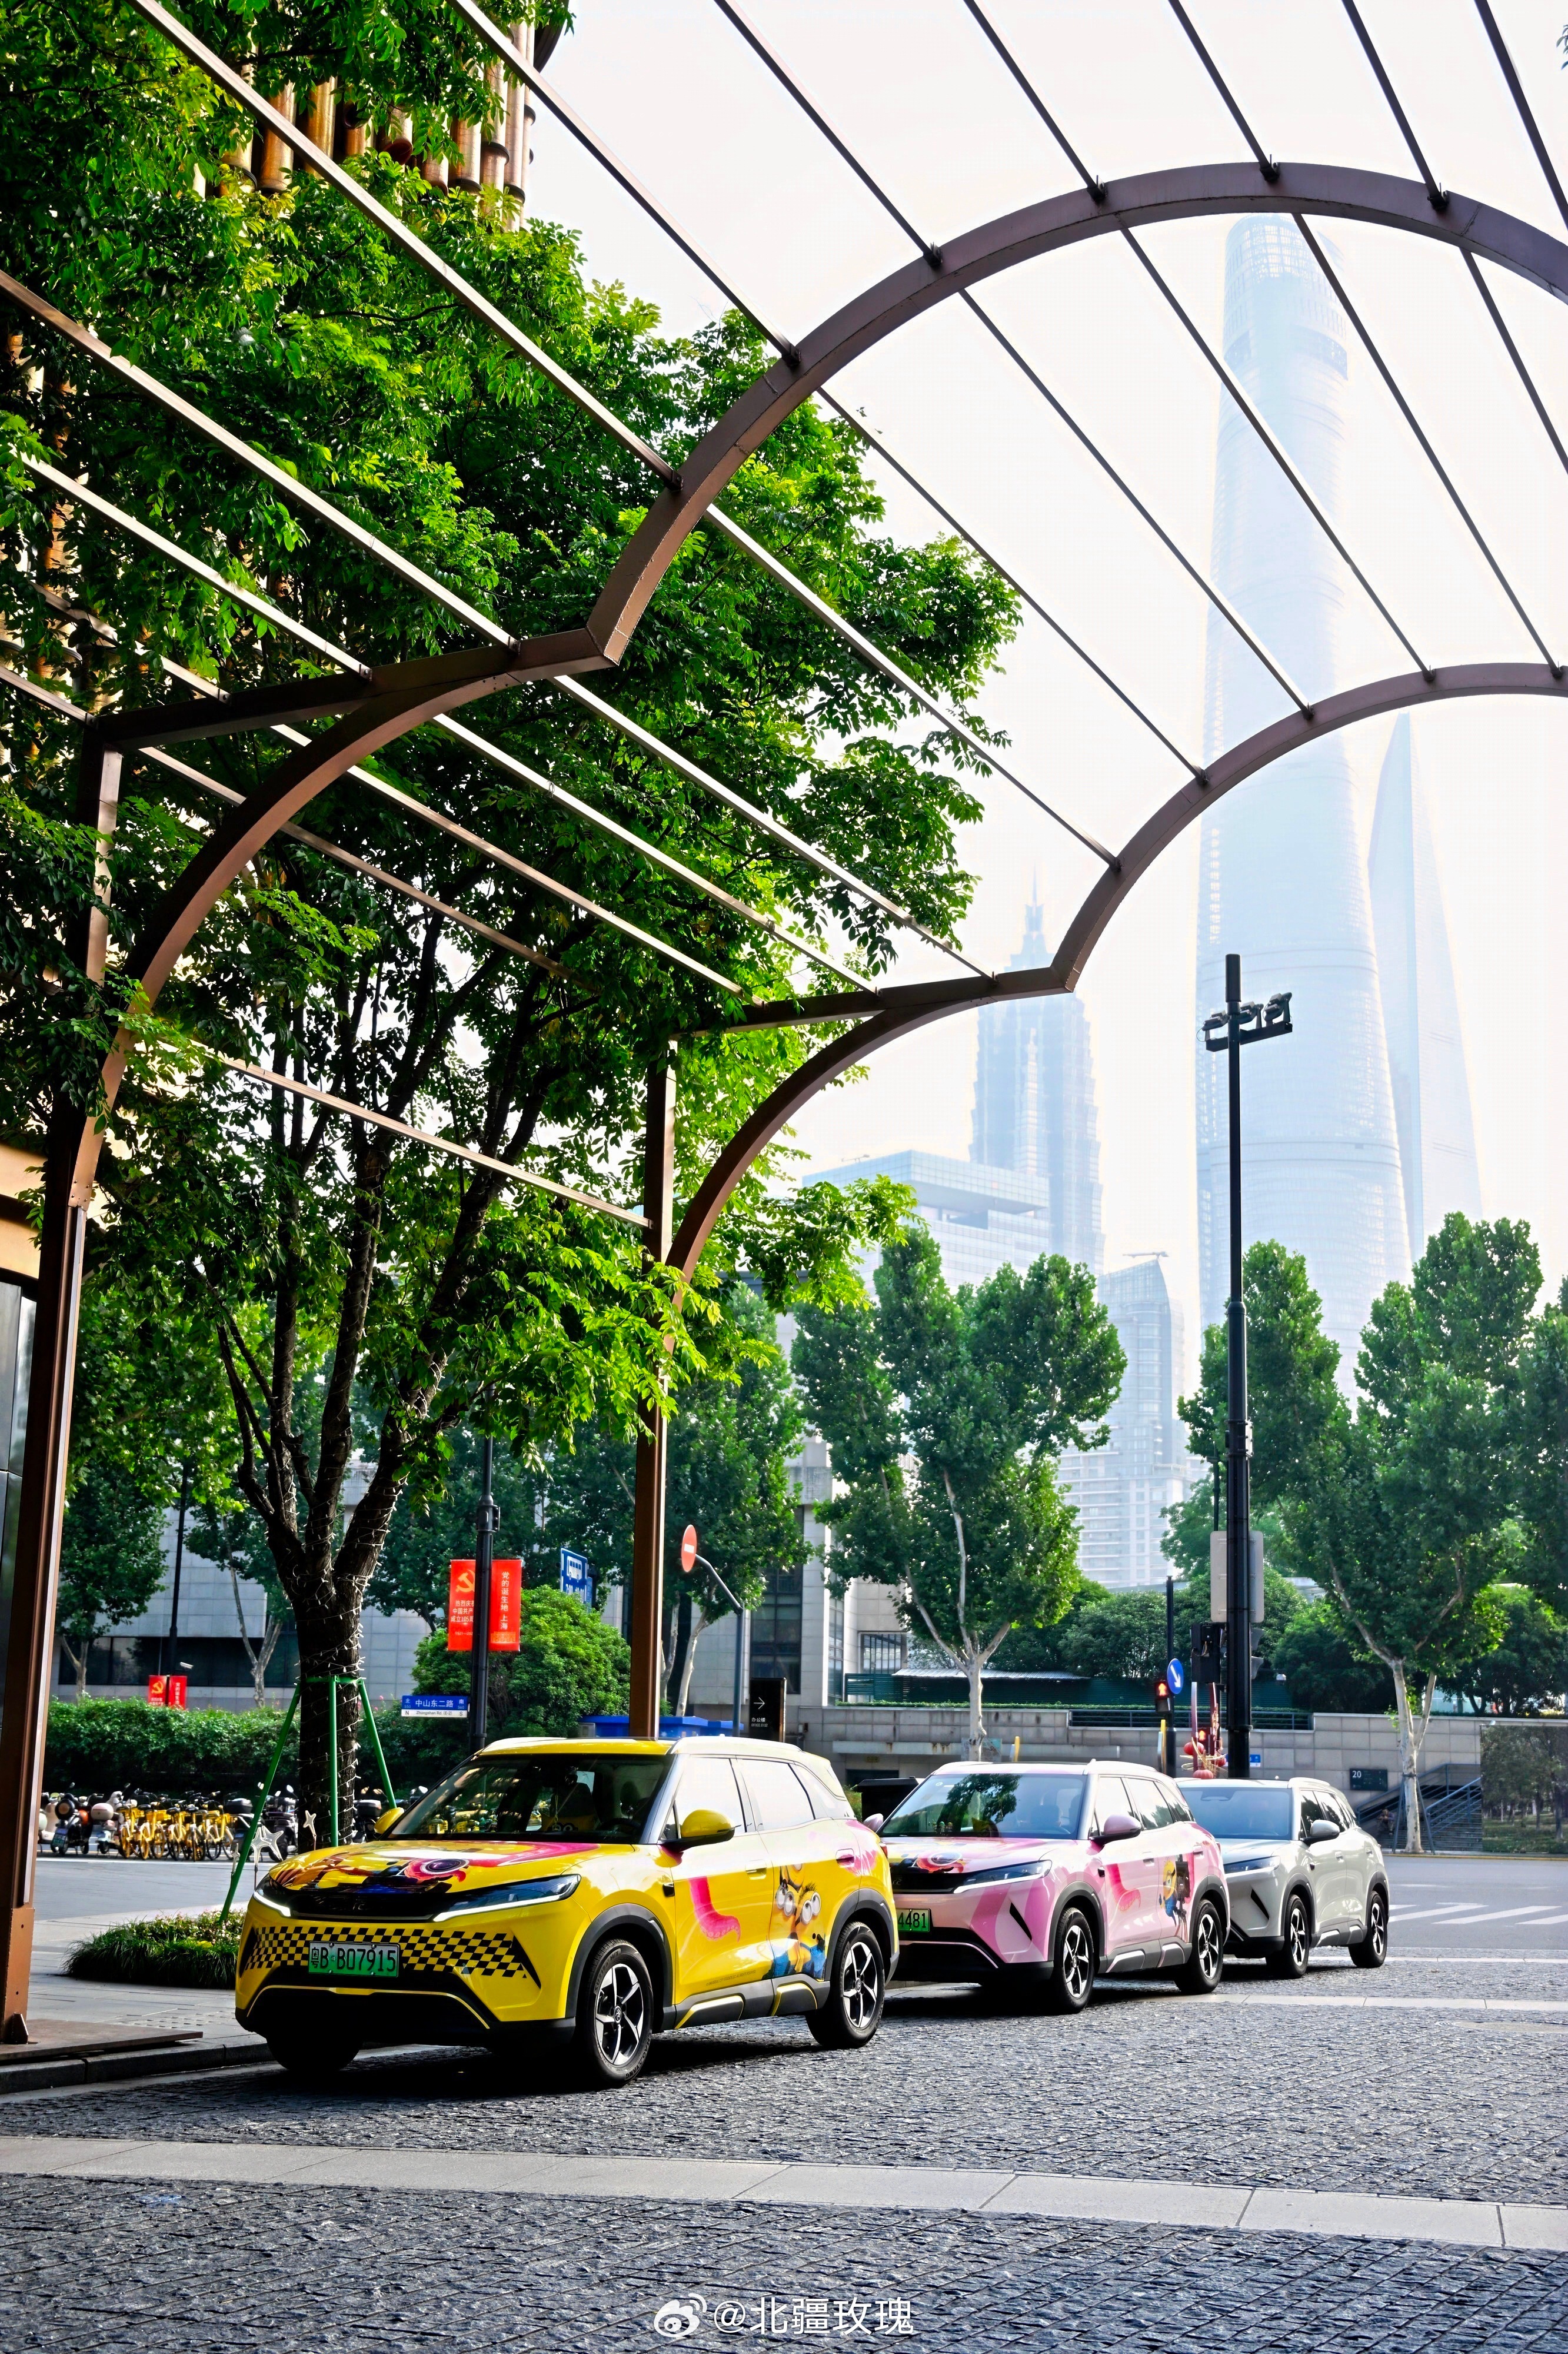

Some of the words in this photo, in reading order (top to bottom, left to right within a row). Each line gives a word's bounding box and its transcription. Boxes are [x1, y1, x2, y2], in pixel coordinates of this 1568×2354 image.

[501, 1572, 510, 1611] 党的诞生地
[500, 1614, 508, 1630] 上海
[415, 1699, 454, 1708] 中山东二路
[898, 1911, 927, 1929] 4481
